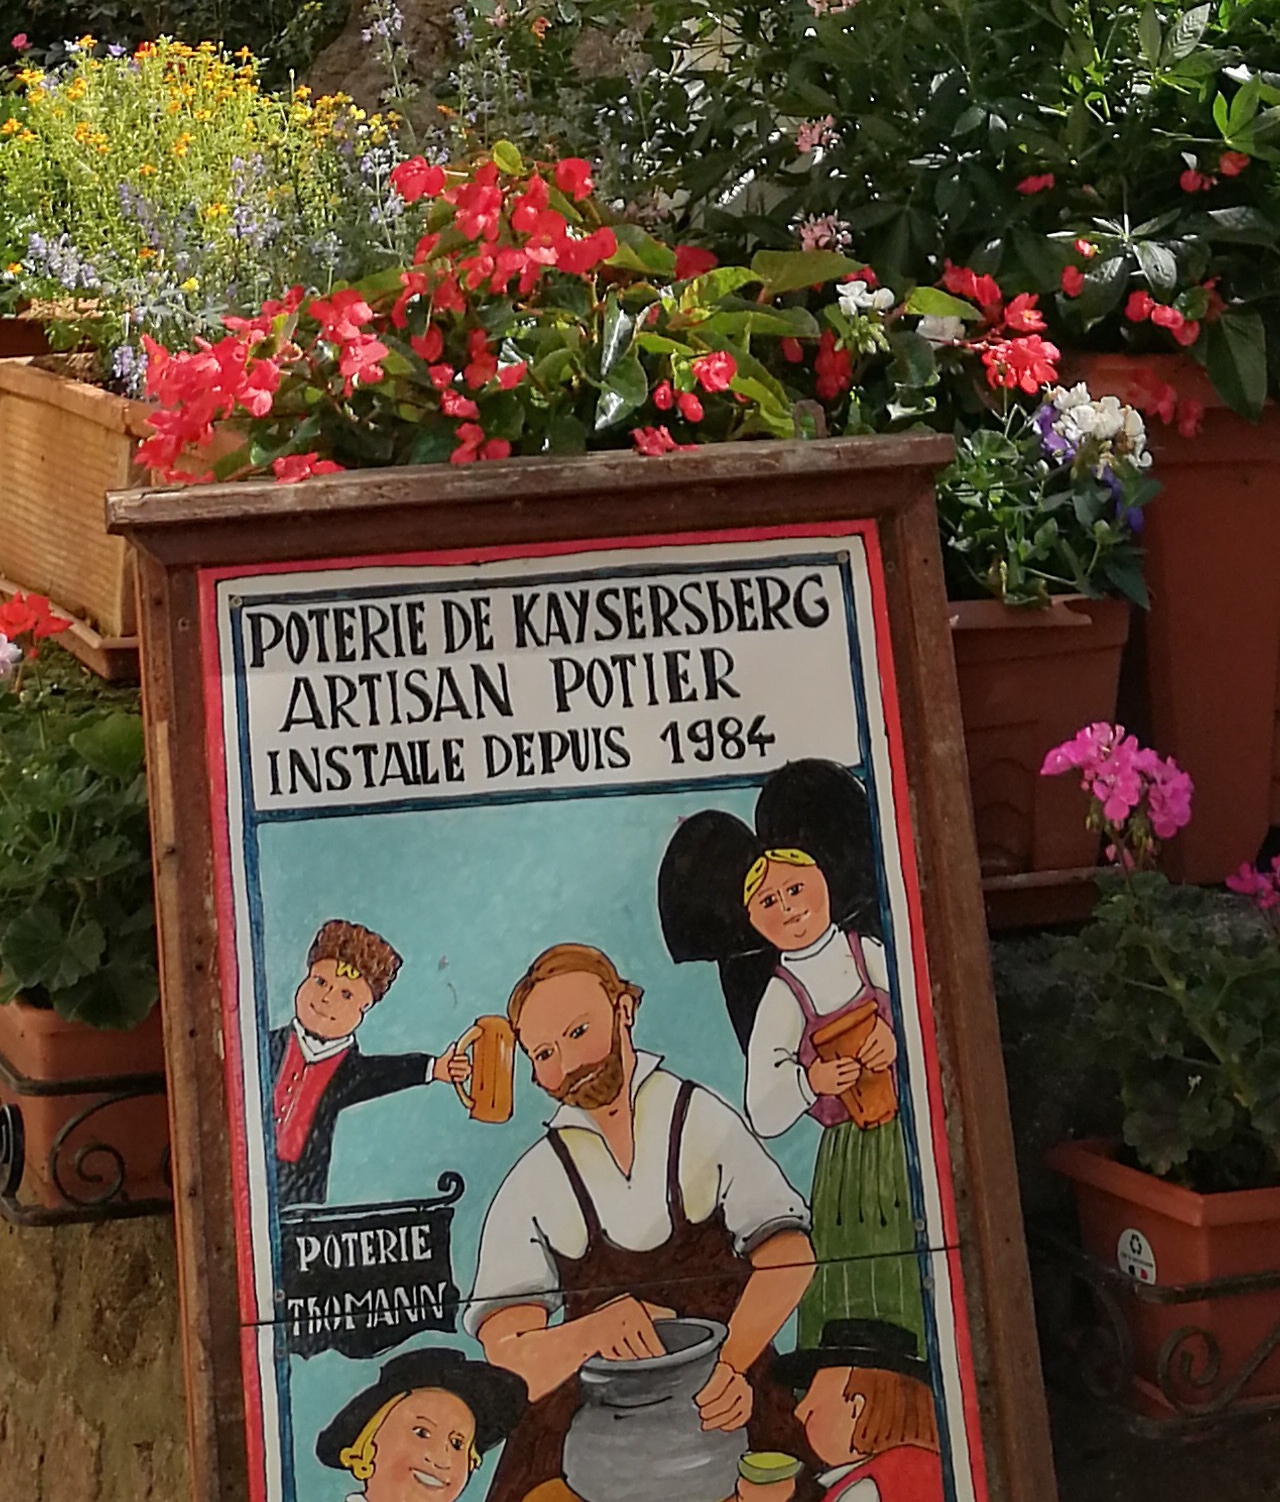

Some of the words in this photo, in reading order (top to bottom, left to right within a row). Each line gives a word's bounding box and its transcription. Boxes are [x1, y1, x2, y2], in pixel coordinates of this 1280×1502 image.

[246, 600, 428, 668] POTERIE
[441, 596, 495, 654] DE
[278, 662, 515, 733] ARTISAN
[549, 647, 741, 714] POTIER
[267, 737, 465, 796] INSTALLE
[482, 725, 632, 779] DEPUIS
[660, 714, 776, 765] 1984
[296, 1224, 432, 1272] POTERIE
